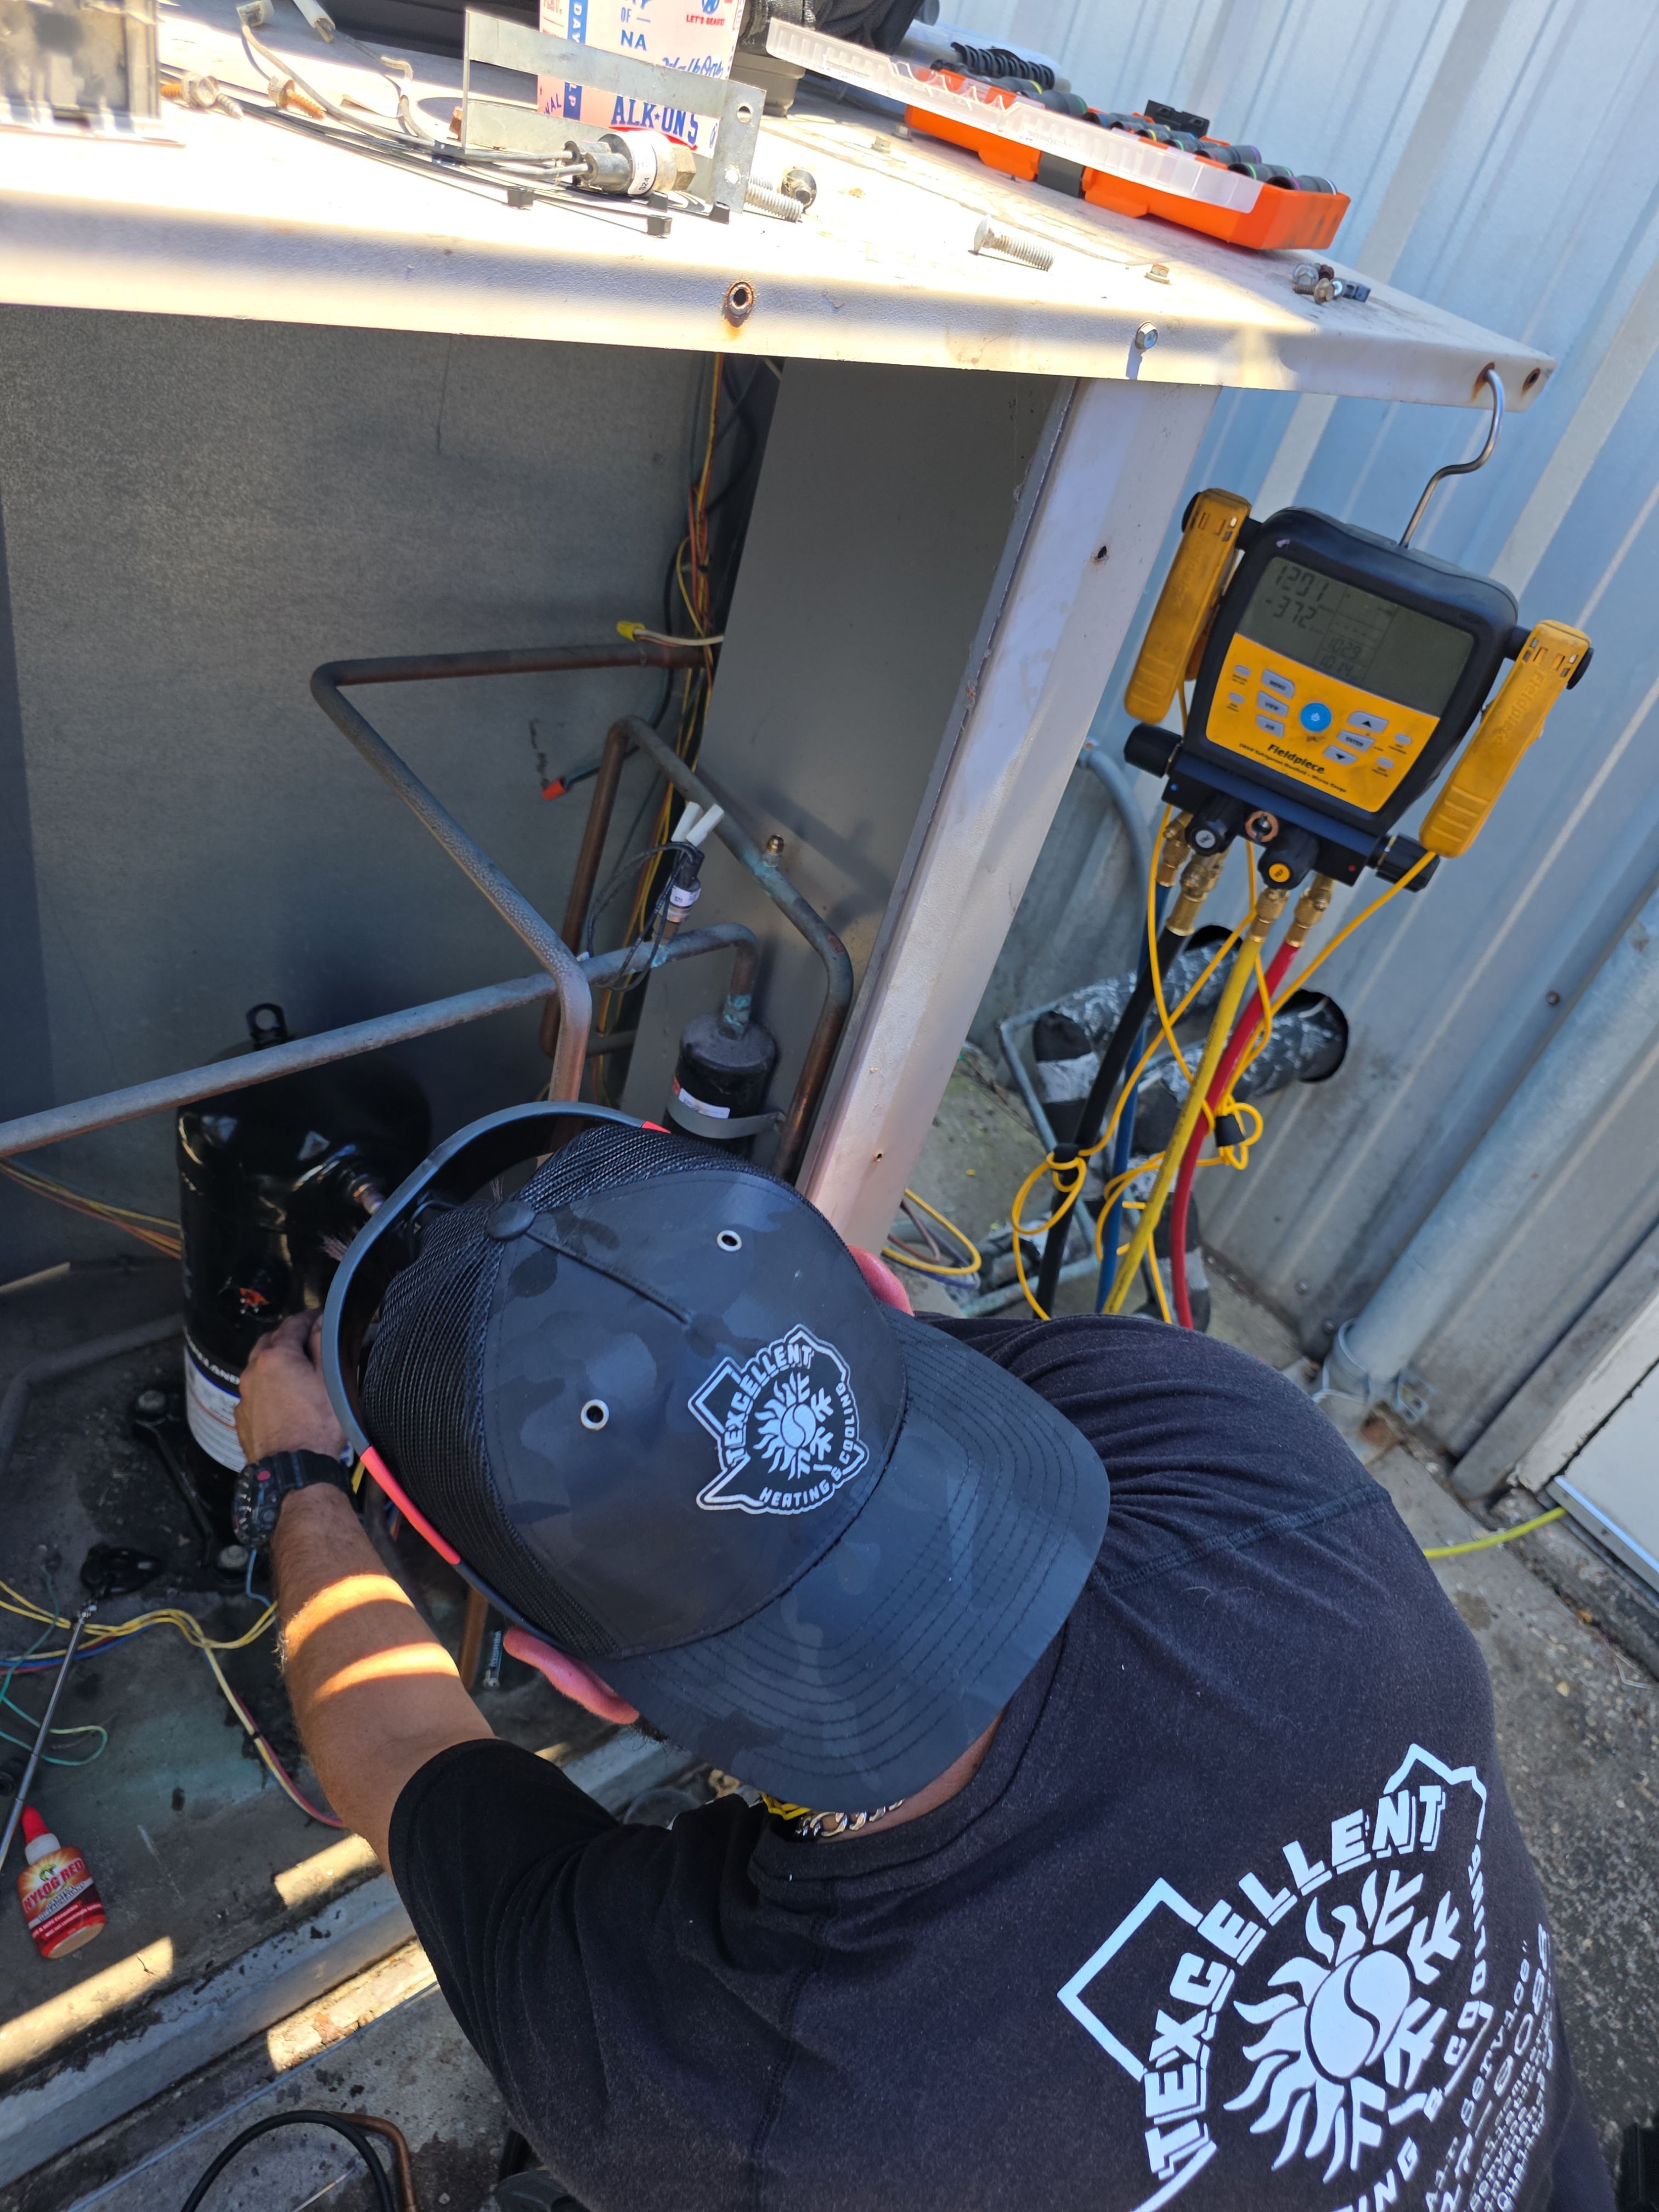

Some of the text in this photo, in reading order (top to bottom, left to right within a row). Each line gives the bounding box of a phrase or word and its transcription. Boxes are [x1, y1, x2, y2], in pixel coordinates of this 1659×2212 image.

[620, 7, 631, 23] OF
[1267, 744, 1325, 774] Fieldpiece
[724, 1342, 815, 1468] TEXCELLENT
[759, 1480, 831, 1508] HEATING
[835, 1381, 856, 1465] COOLING
[23, 1876, 61, 1910] NYLOG
[60, 1859, 83, 1883] RED
[1144, 1784, 1447, 2181] TEXCELLENT
